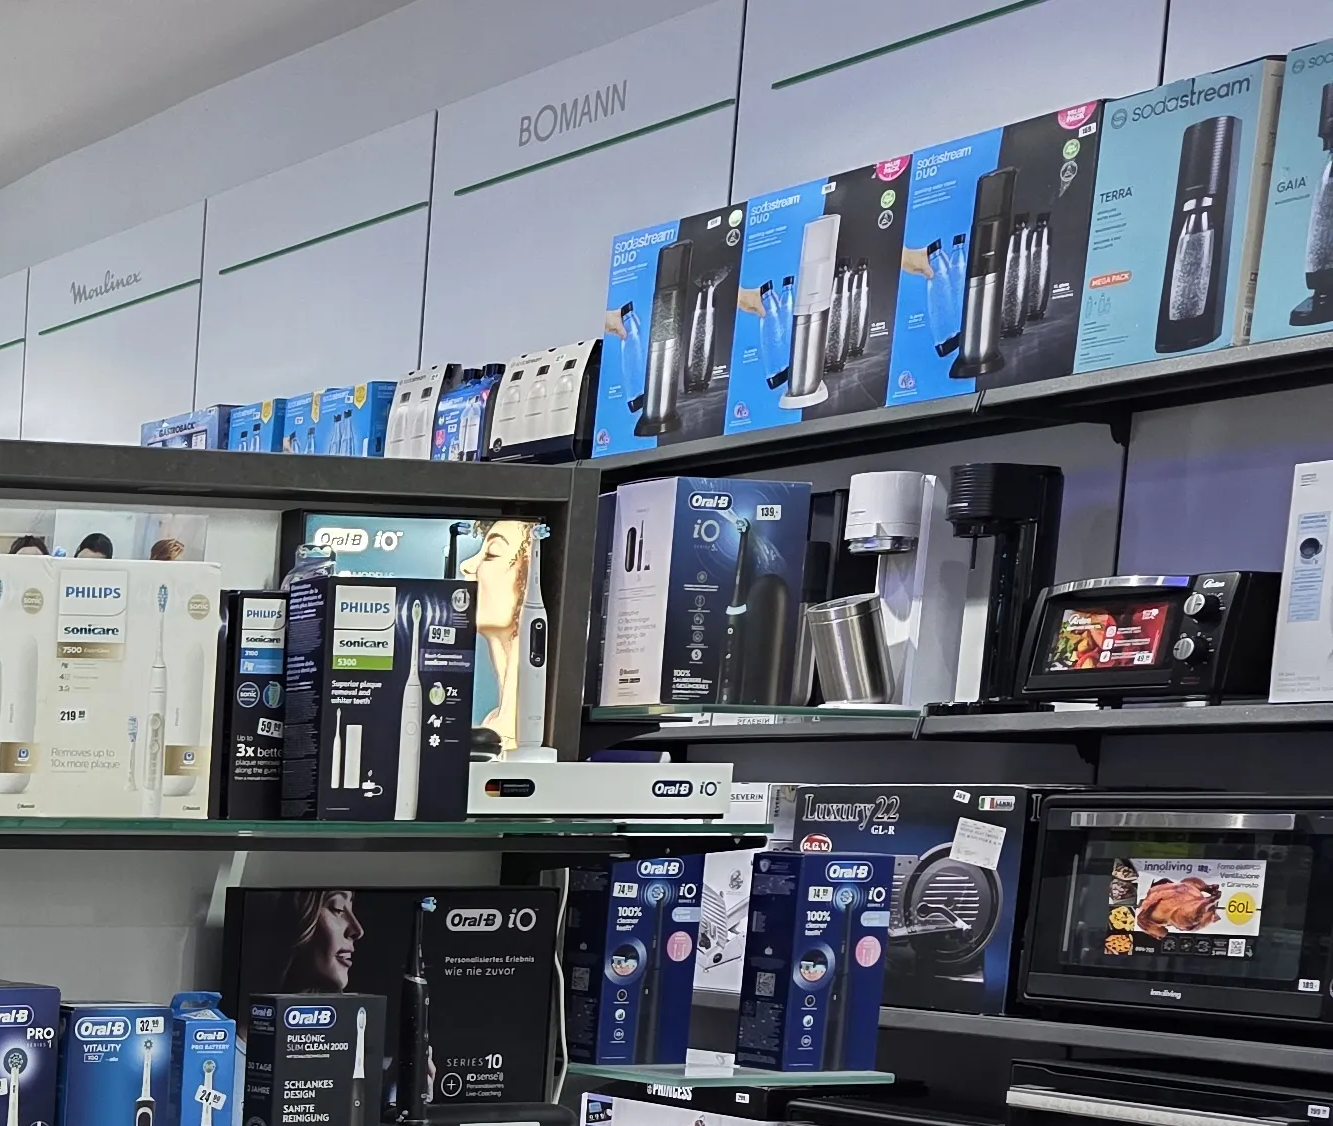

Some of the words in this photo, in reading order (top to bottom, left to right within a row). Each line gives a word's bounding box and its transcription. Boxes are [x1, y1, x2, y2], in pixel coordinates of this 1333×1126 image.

[1132, 76, 1251, 122] sodastream
[519, 80, 627, 147] BOMANN
[917, 146, 972, 170] sodastream
[915, 167, 937, 181] DUO
[1276, 178, 1307, 193] GAIA
[1100, 187, 1132, 203] TERRA
[751, 194, 801, 215] sodastream
[750, 212, 770, 226] DUO
[615, 228, 677, 252] sodastream
[613, 250, 637, 267] DUO
[1092, 274, 1112, 286] MEGA
[1112, 270, 1131, 283] PACK
[70, 270, 142, 304] Moulinex
[159, 422, 195, 438] GASTROBACK
[692, 495, 729, 509] Oral-B
[693, 519, 720, 542] iO
[65, 587, 121, 599] PHILIPS
[246, 609, 282, 619] PHILIPS
[340, 601, 390, 614] PHILIPS
[64, 624, 119, 636] sonicare
[245, 635, 281, 645] sonicare
[339, 638, 389, 649] sonicare
[337, 658, 357, 666] 5300
[331, 680, 358, 689] Superior
[359, 681, 382, 690] plaque
[331, 688, 355, 697] removal
[359, 688, 371, 696] and
[52, 748, 92, 758] Removes
[93, 750, 105, 759] up
[106, 748, 116, 758] to
[51, 759, 66, 768] 10x
[68, 761, 90, 769] more
[91, 760, 121, 771] plaque
[235, 766, 251, 776] along
[253, 766, 263, 774] the
[264, 767, 277, 775] gum
[654, 782, 690, 794] Oral-B
[699, 781, 718, 797] iO
[730, 793, 764, 801] SEVERIN
[870, 825, 895, 835] GL-R
[640, 861, 680, 875] Oral-B
[829, 865, 869, 879] Oral-B
[1144, 860, 1193, 874] innoliving
[1219, 872, 1260, 880] Ventilazione
[617, 907, 642, 917] 100%
[1227, 899, 1254, 914] 60L
[450, 912, 496, 928] Oral-B
[507, 908, 537, 933] iO
[806, 910, 831, 921] 100%
[444, 955, 504, 964] Personalisiertes
[506, 955, 535, 963] Erlebnis
[444, 966, 463, 977] wie
[466, 966, 483, 977] nie
[485, 966, 516, 977] zuvor
[288, 1010, 332, 1026] Oral-B
[26, 1027, 55, 1040] PRO
[80, 1021, 125, 1037] Oral-B
[195, 1030, 226, 1041] Oral-B
[83, 1044, 122, 1053] VITALITY
[286, 1043, 304, 1052] SLIM
[304, 1042, 330, 1051] CLEAN
[330, 1042, 349, 1051] 2000
[446, 1056, 484, 1068] SERIES
[485, 1053, 503, 1070] 10
[284, 1080, 334, 1090] SCHLANKES
[284, 1090, 316, 1100] DESIGN
[283, 1104, 316, 1114] SANFTE
[282, 1114, 331, 1124] REINIGUNG
